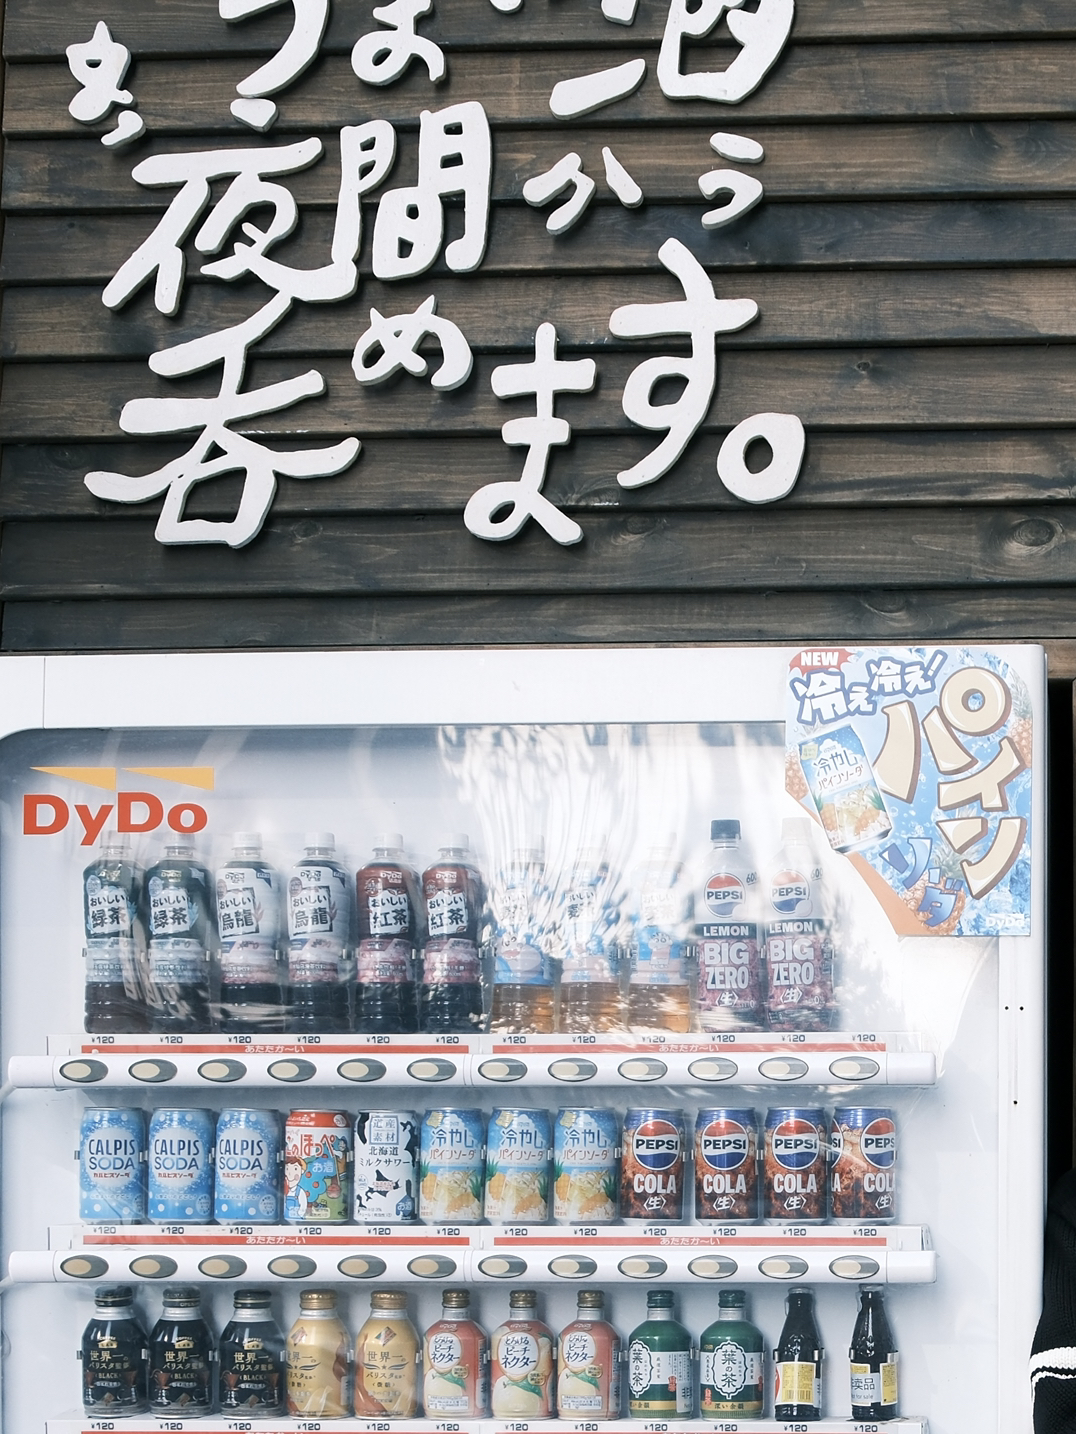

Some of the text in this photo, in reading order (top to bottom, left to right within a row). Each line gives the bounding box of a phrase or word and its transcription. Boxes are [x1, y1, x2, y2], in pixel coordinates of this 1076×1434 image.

[801, 652, 839, 666] NEW
[813, 749, 859, 777] 冷やし
[818, 764, 863, 791] パインソーダ
[22, 792, 209, 846] DyDo
[706, 890, 743, 900] PEPSI
[772, 887, 807, 897] PEPSI
[90, 894, 125, 907] おいしい
[152, 894, 187, 908] おいしい
[219, 897, 252, 910] おいしい
[292, 895, 328, 906] おいしい
[371, 896, 407, 907] おいしい
[428, 896, 464, 909] おいしい
[153, 908, 188, 930] 緑茶
[221, 909, 254, 931] 烏龍
[294, 907, 329, 929] 烏龍
[372, 908, 407, 929] 紅茶
[430, 909, 465, 931] 紅茶
[703, 926, 749, 937] LEMON
[769, 922, 813, 934] LEMON
[704, 942, 750, 965] BIG
[769, 938, 815, 962] BIG
[705, 966, 749, 990] ZERO
[771, 962, 815, 986] ZERO
[91, 1036, 459, 1044] ¥120 ¥120 ¥120 ¥120 ¥120 ¥120
[502, 1036, 526, 1044] ¥120
[572, 1036, 596, 1044] ¥120
[711, 1034, 736, 1043] ¥120
[852, 1034, 876, 1043] ¥120
[431, 1128, 475, 1148] 冷やし
[501, 1129, 544, 1150] 冷やし
[564, 1129, 606, 1150] 冷やし
[703, 1139, 747, 1150] PEPSI
[774, 1139, 818, 1149] PEPSI
[89, 1139, 136, 1156] CALPIS
[154, 1139, 200, 1156] CALPIS
[219, 1139, 263, 1156] CALPIS
[368, 1146, 399, 1156] 北海道
[635, 1139, 678, 1151] PEPSI
[429, 1149, 477, 1160] パインソーダ
[498, 1149, 545, 1161] パインソーダ
[562, 1149, 610, 1161] パインソーダ
[89, 1157, 137, 1170] SODA
[154, 1157, 200, 1170] SODA
[219, 1157, 263, 1170] SODA
[311, 1160, 335, 1173] お酒
[359, 1158, 411, 1168] ミルクサワー
[633, 1174, 677, 1194] COLA
[703, 1174, 747, 1193] COLA
[773, 1174, 818, 1193] COLA
[93, 1227, 460, 1235] ¥120 ¥120 ¥120 ¥120 ¥120 ¥120
[504, 1228, 877, 1237] ¥120 ¥120 ¥120 ¥120 ¥120 ¥120
[434, 1344, 454, 1352] ピーチ
[506, 1346, 531, 1355] ピーチ
[431, 1352, 460, 1363] ネクター
[501, 1355, 537, 1368] ネクター
[565, 1351, 594, 1363] ネクター
[721, 1349, 738, 1388] 葉の茶
[91, 1423, 460, 1431] ¥120 ¥120 ¥120 ¥120 ¥120 ¥120
[505, 1424, 878, 1432] ¥120 ¥120 ¥120 ¥120 ¥120 ¥120
